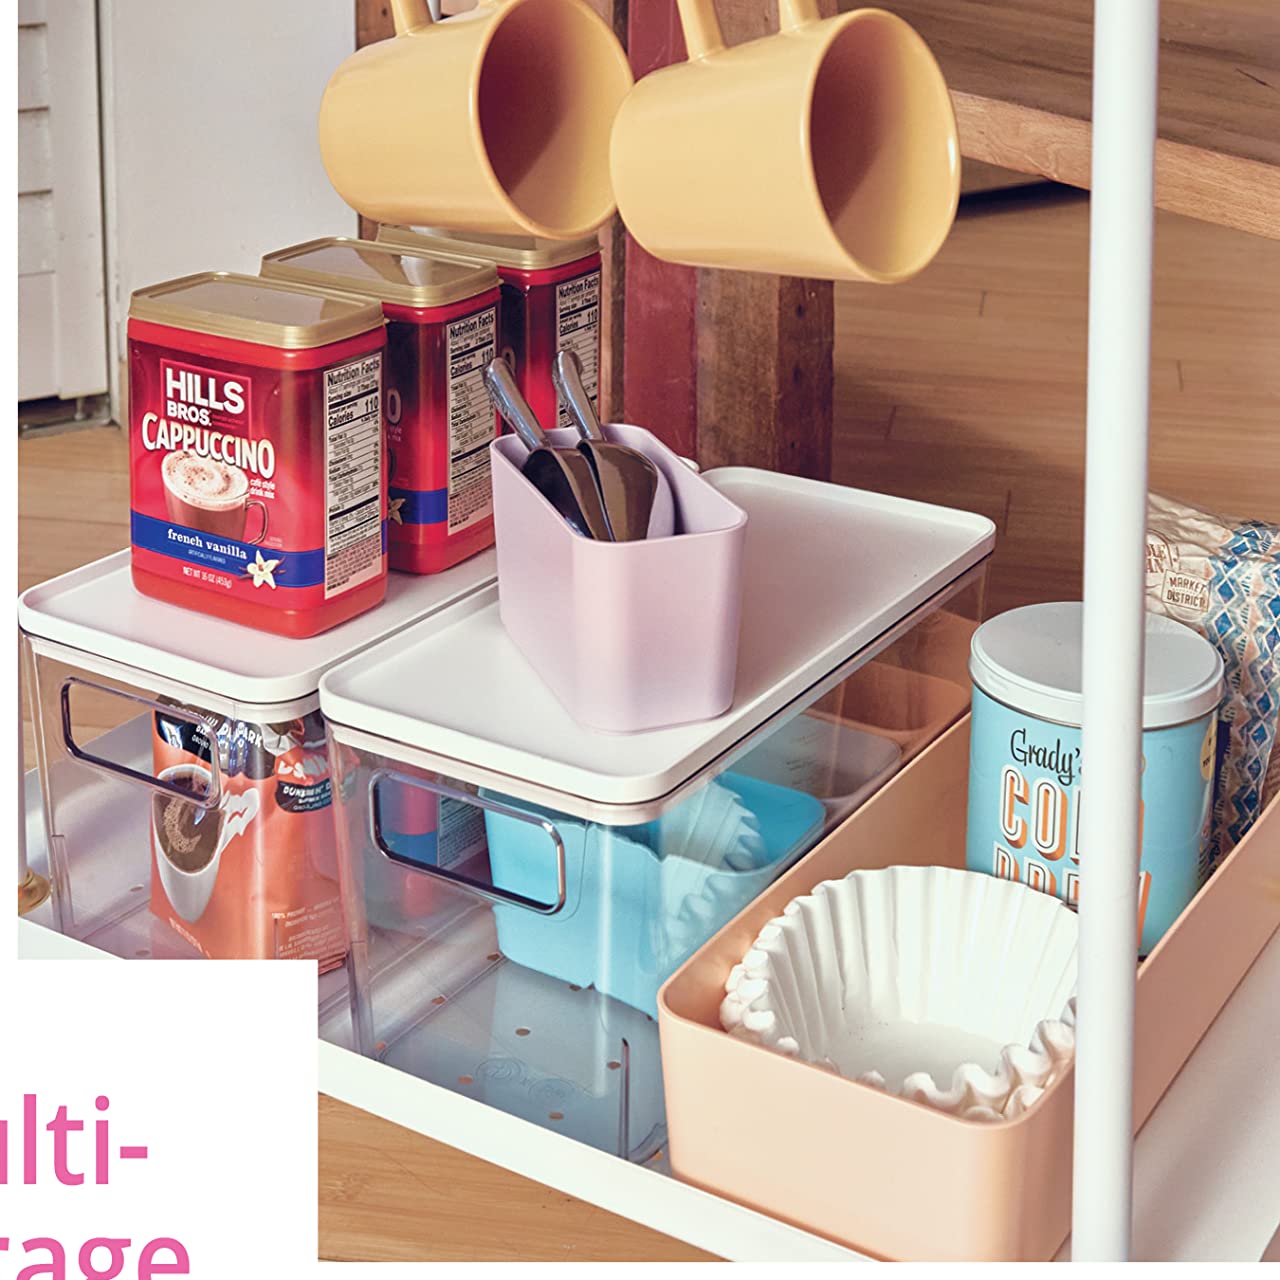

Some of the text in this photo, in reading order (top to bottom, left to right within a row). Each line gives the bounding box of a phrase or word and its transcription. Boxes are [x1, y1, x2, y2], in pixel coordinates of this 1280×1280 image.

[450, 312, 494, 339] Nutrition Facts
[327, 366, 360, 387] Nutrition
[361, 359, 380, 376] Facts
[166, 367, 245, 415] HILLS
[328, 411, 354, 428] Calories
[365, 396, 379, 413] 110
[142, 412, 275, 479] CAPPUCCINO
[167, 528, 248, 560] french vanilla
[1166, 589, 1206, 608] DISTRICT
[1169, 577, 1206, 594] MARKET
[1010, 727, 1082, 787] Grady'
